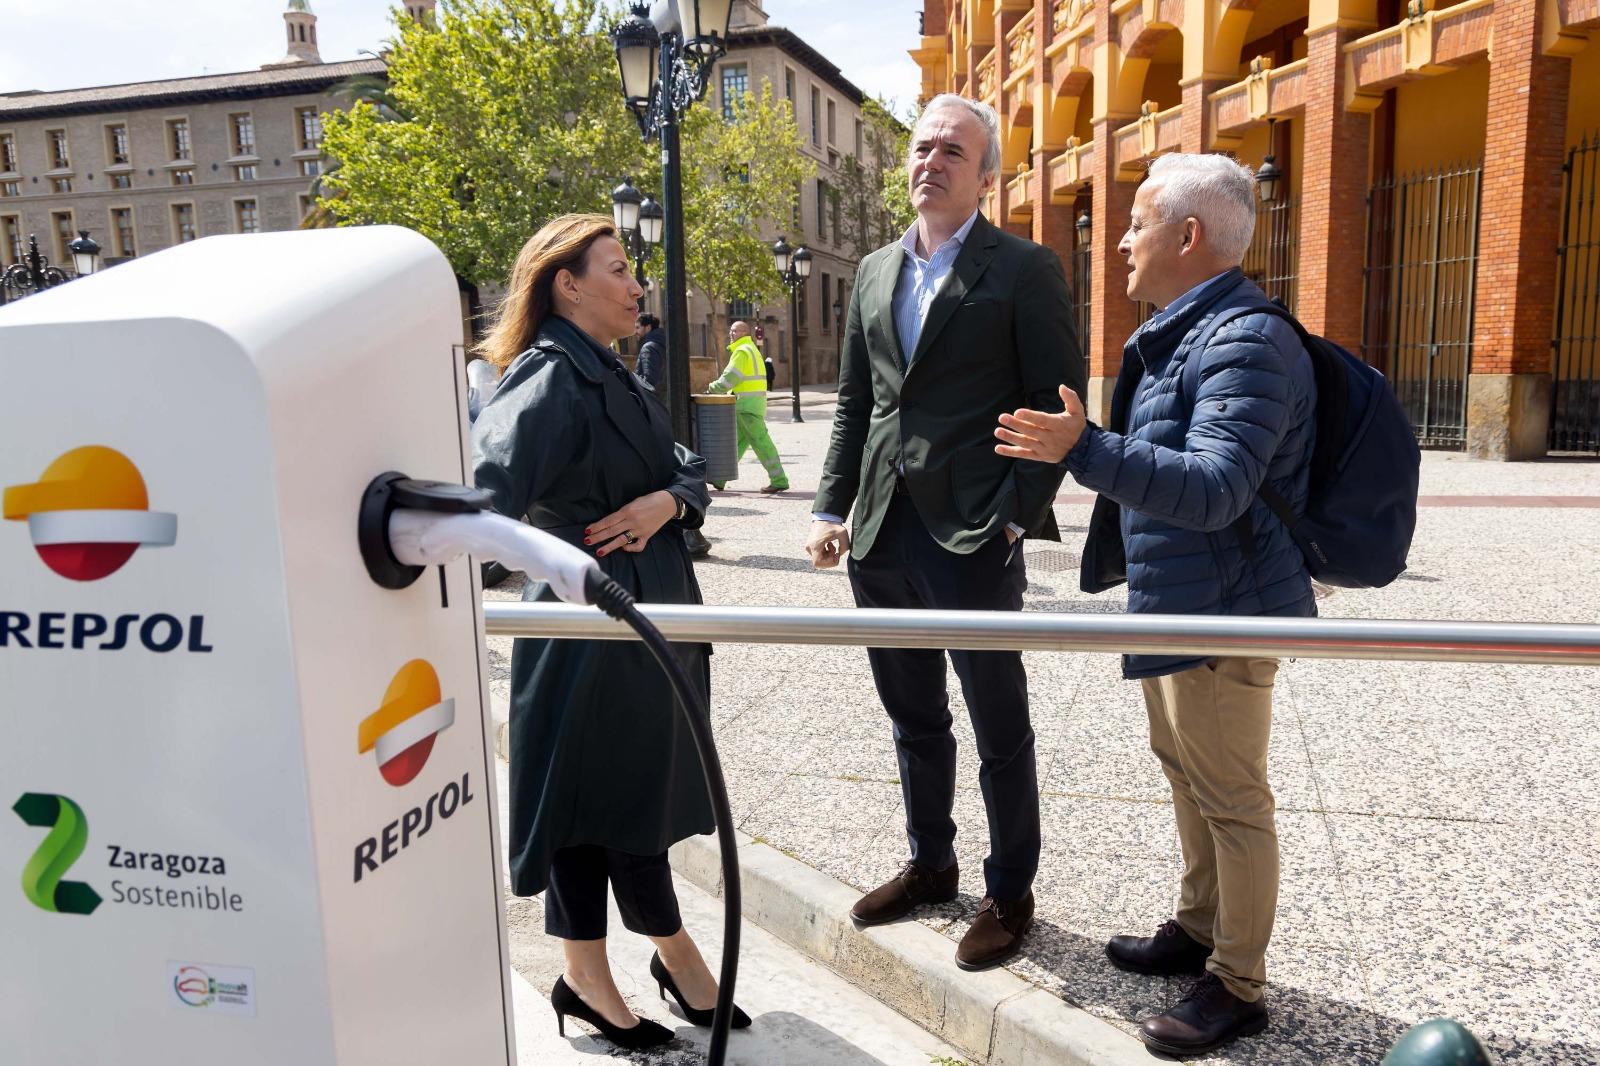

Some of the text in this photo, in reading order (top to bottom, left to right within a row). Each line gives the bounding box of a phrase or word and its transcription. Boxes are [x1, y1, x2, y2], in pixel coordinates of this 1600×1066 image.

[0, 611, 213, 653] REPSOL
[353, 771, 474, 884] REPSOL
[107, 845, 226, 878] Zaragoza
[111, 880, 243, 912] Sostenible
